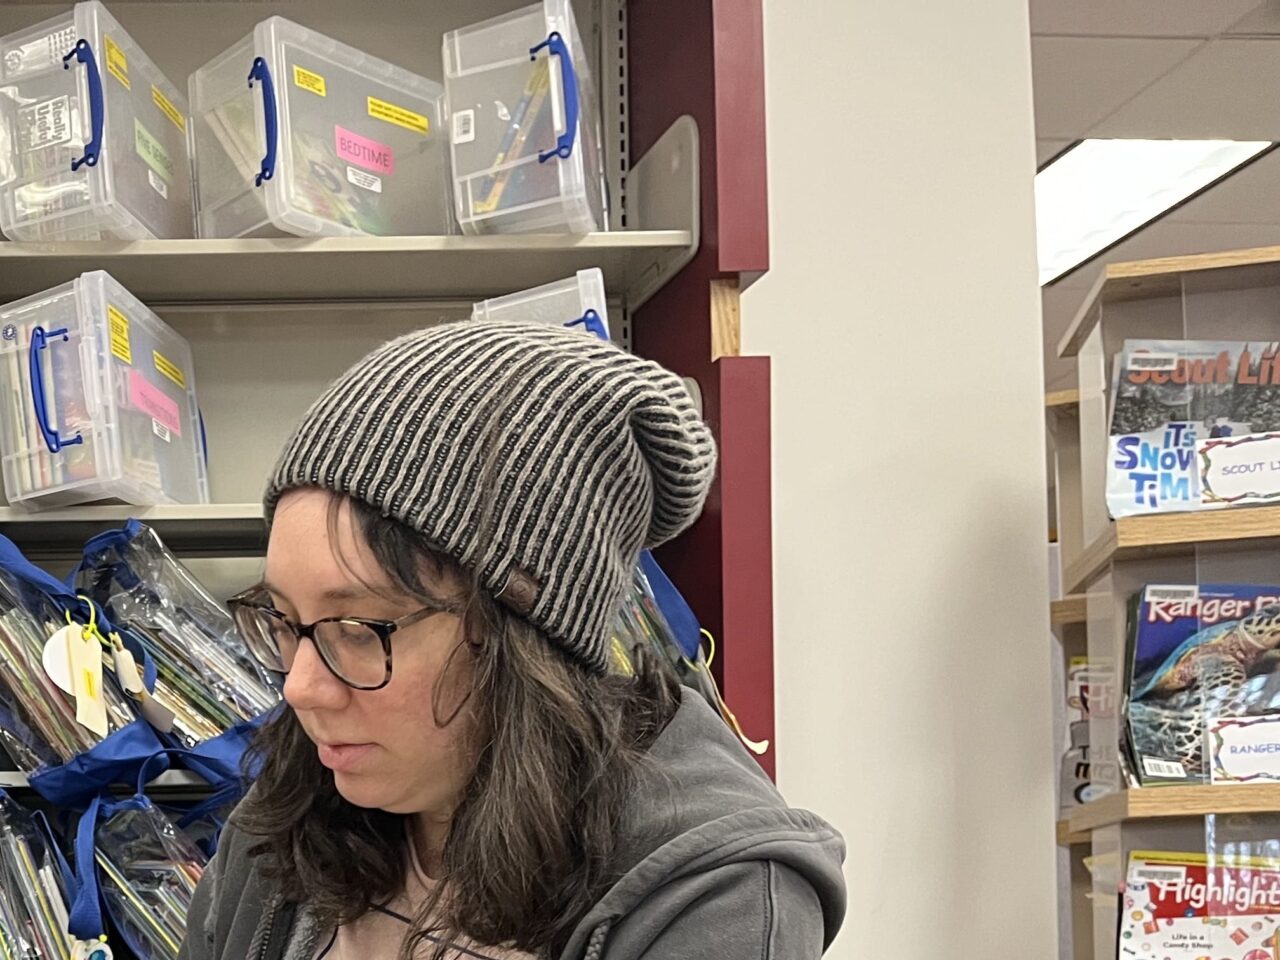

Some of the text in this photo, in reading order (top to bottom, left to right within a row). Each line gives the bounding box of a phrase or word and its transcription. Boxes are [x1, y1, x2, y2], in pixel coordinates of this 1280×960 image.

[339, 137, 391, 168] BEDTIME
[1222, 462, 1265, 475] SCOUT
[1148, 597, 1250, 622] Ranger
